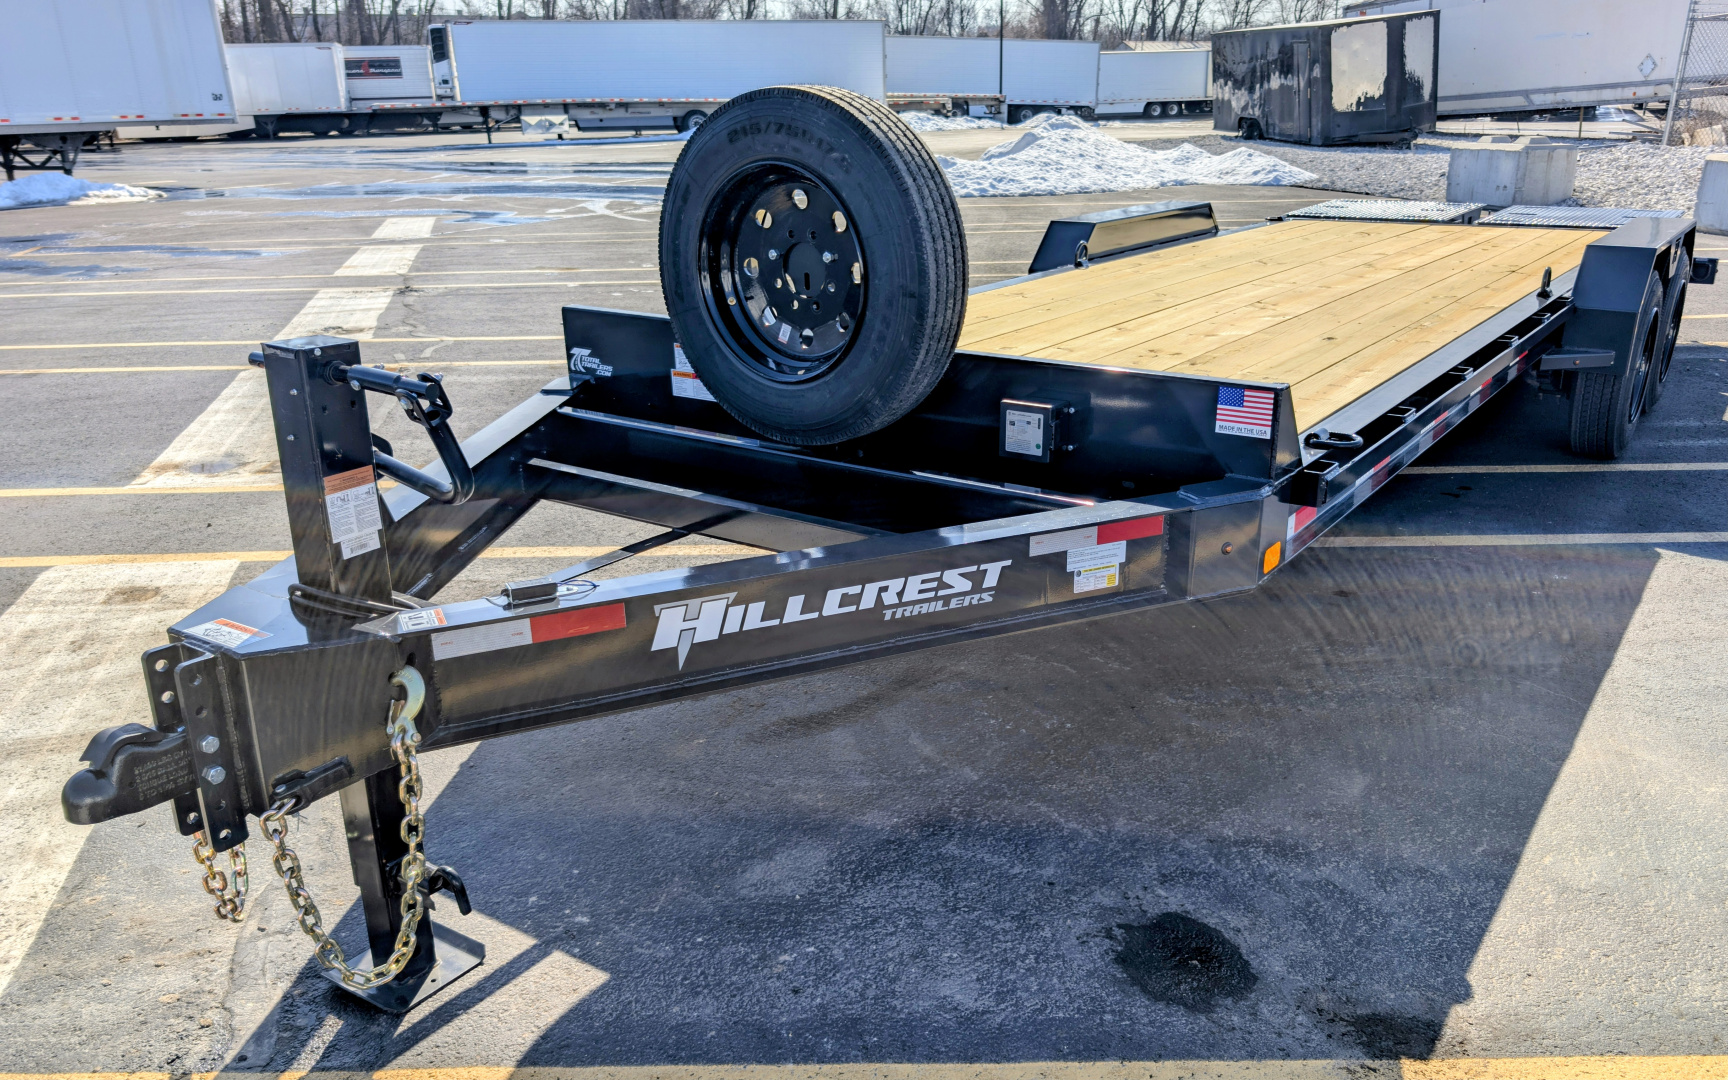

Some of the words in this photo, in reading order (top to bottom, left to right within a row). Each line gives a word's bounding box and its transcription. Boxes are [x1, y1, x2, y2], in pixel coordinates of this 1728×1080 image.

[582, 356, 602, 365] TOTAL
[581, 361, 614, 372] TRAILERS
[1218, 424, 1236, 432] MADE
[1243, 427, 1255, 435] THE
[882, 591, 996, 621] TRAILERS
[650, 559, 1013, 671] HILLCREST
